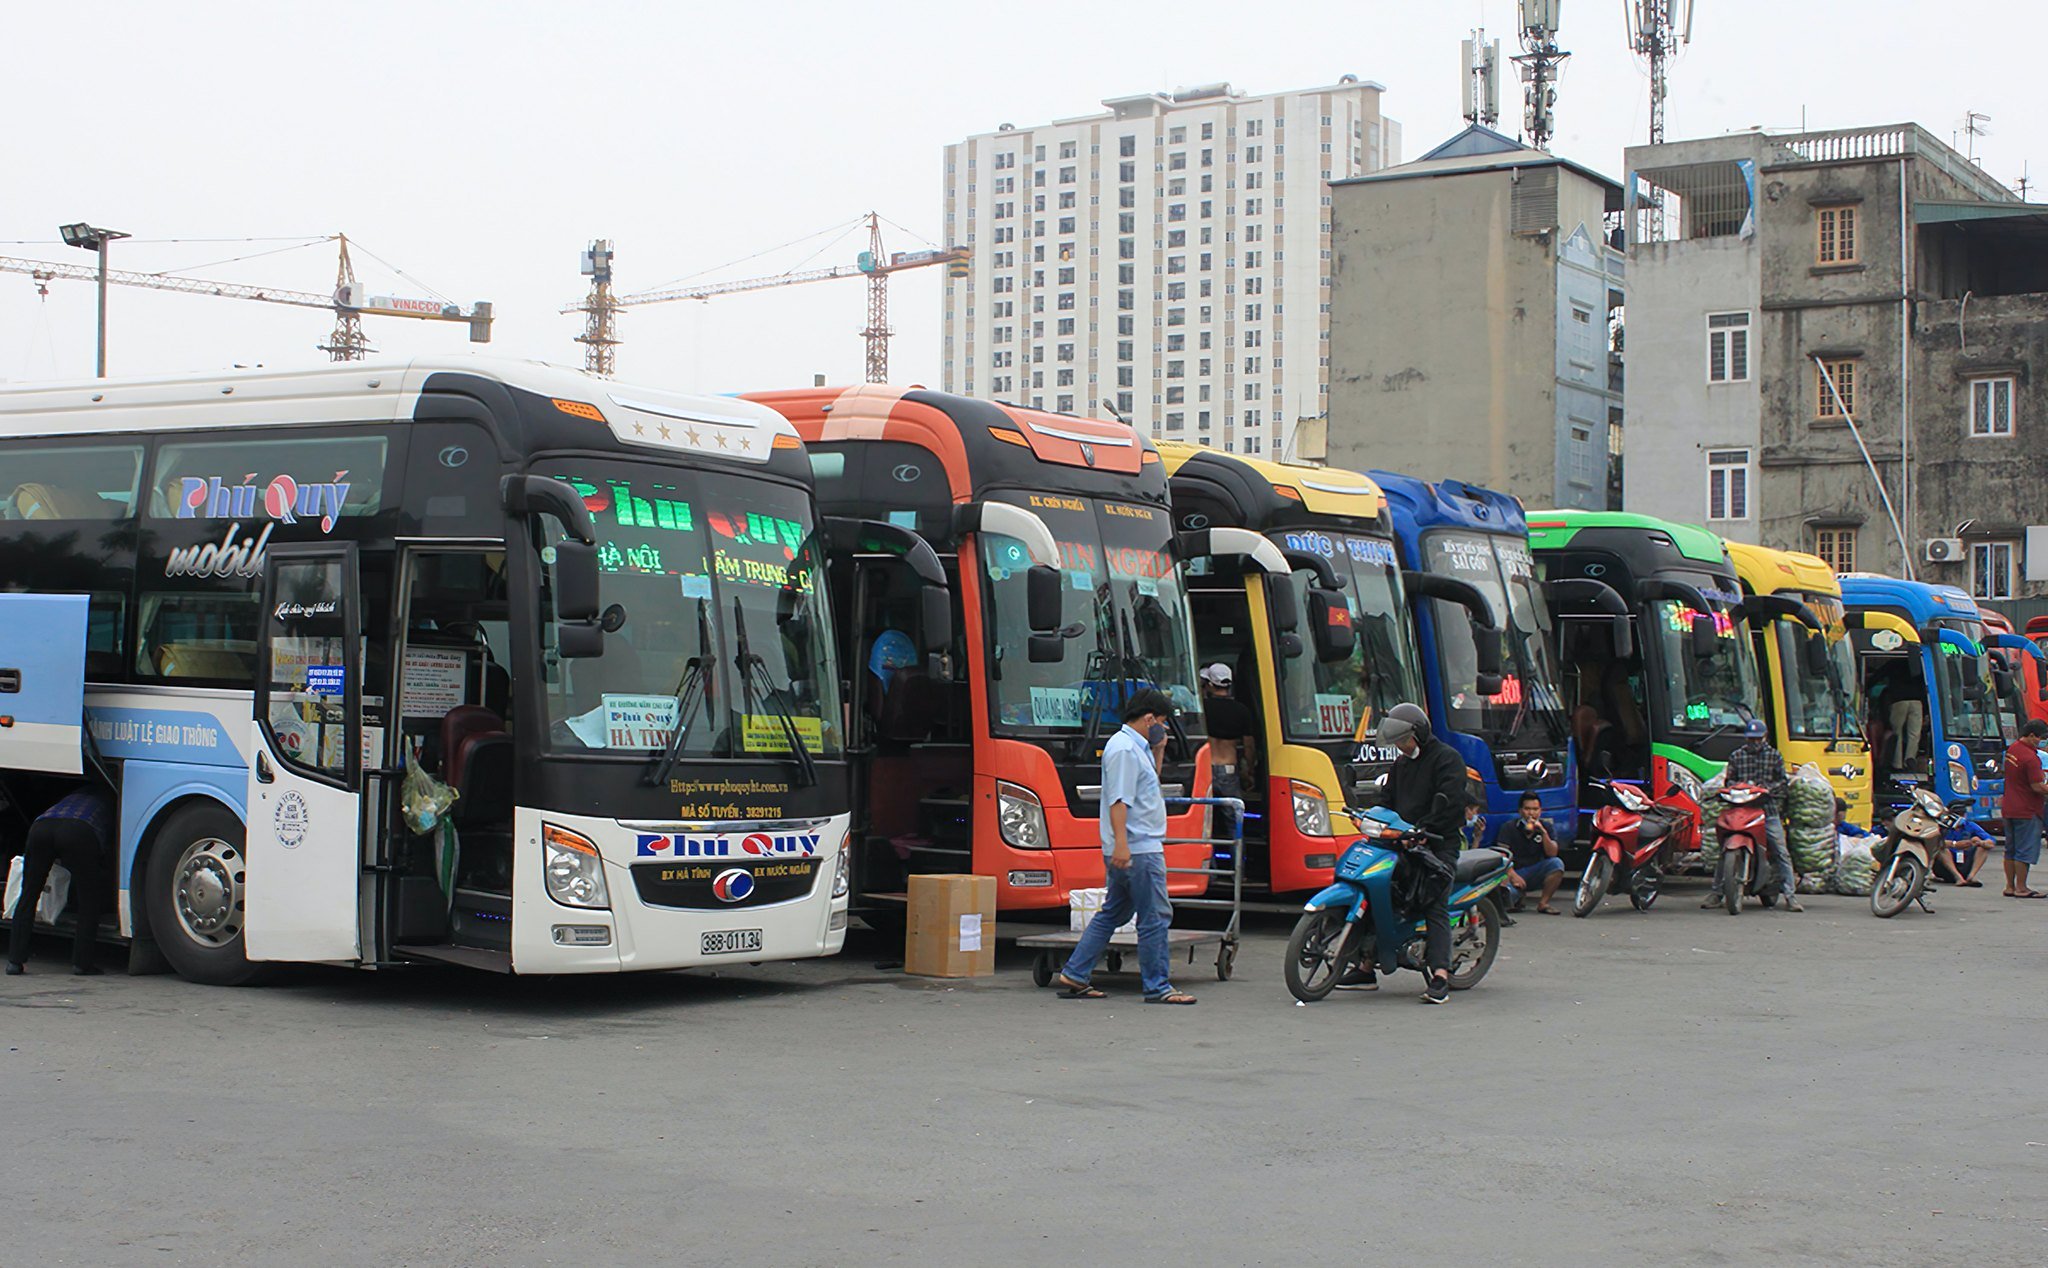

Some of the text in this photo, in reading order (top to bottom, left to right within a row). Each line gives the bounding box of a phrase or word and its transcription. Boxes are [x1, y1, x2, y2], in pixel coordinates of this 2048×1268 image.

[392, 299, 441, 313] VINACCO
[175, 470, 351, 534] Phú Quý
[742, 558, 789, 585] TRUNG
[1320, 699, 1353, 733] HUẾ
[114, 719, 140, 745] LUẬT
[141, 720, 153, 746] LỆ
[155, 724, 180, 745] GIAO
[182, 723, 218, 748] THÔNG
[610, 724, 636, 746] HÀ
[698, 802, 711, 818] SỐ
[636, 829, 821, 858] Phú Quý
[676, 868, 689, 880] HÀ
